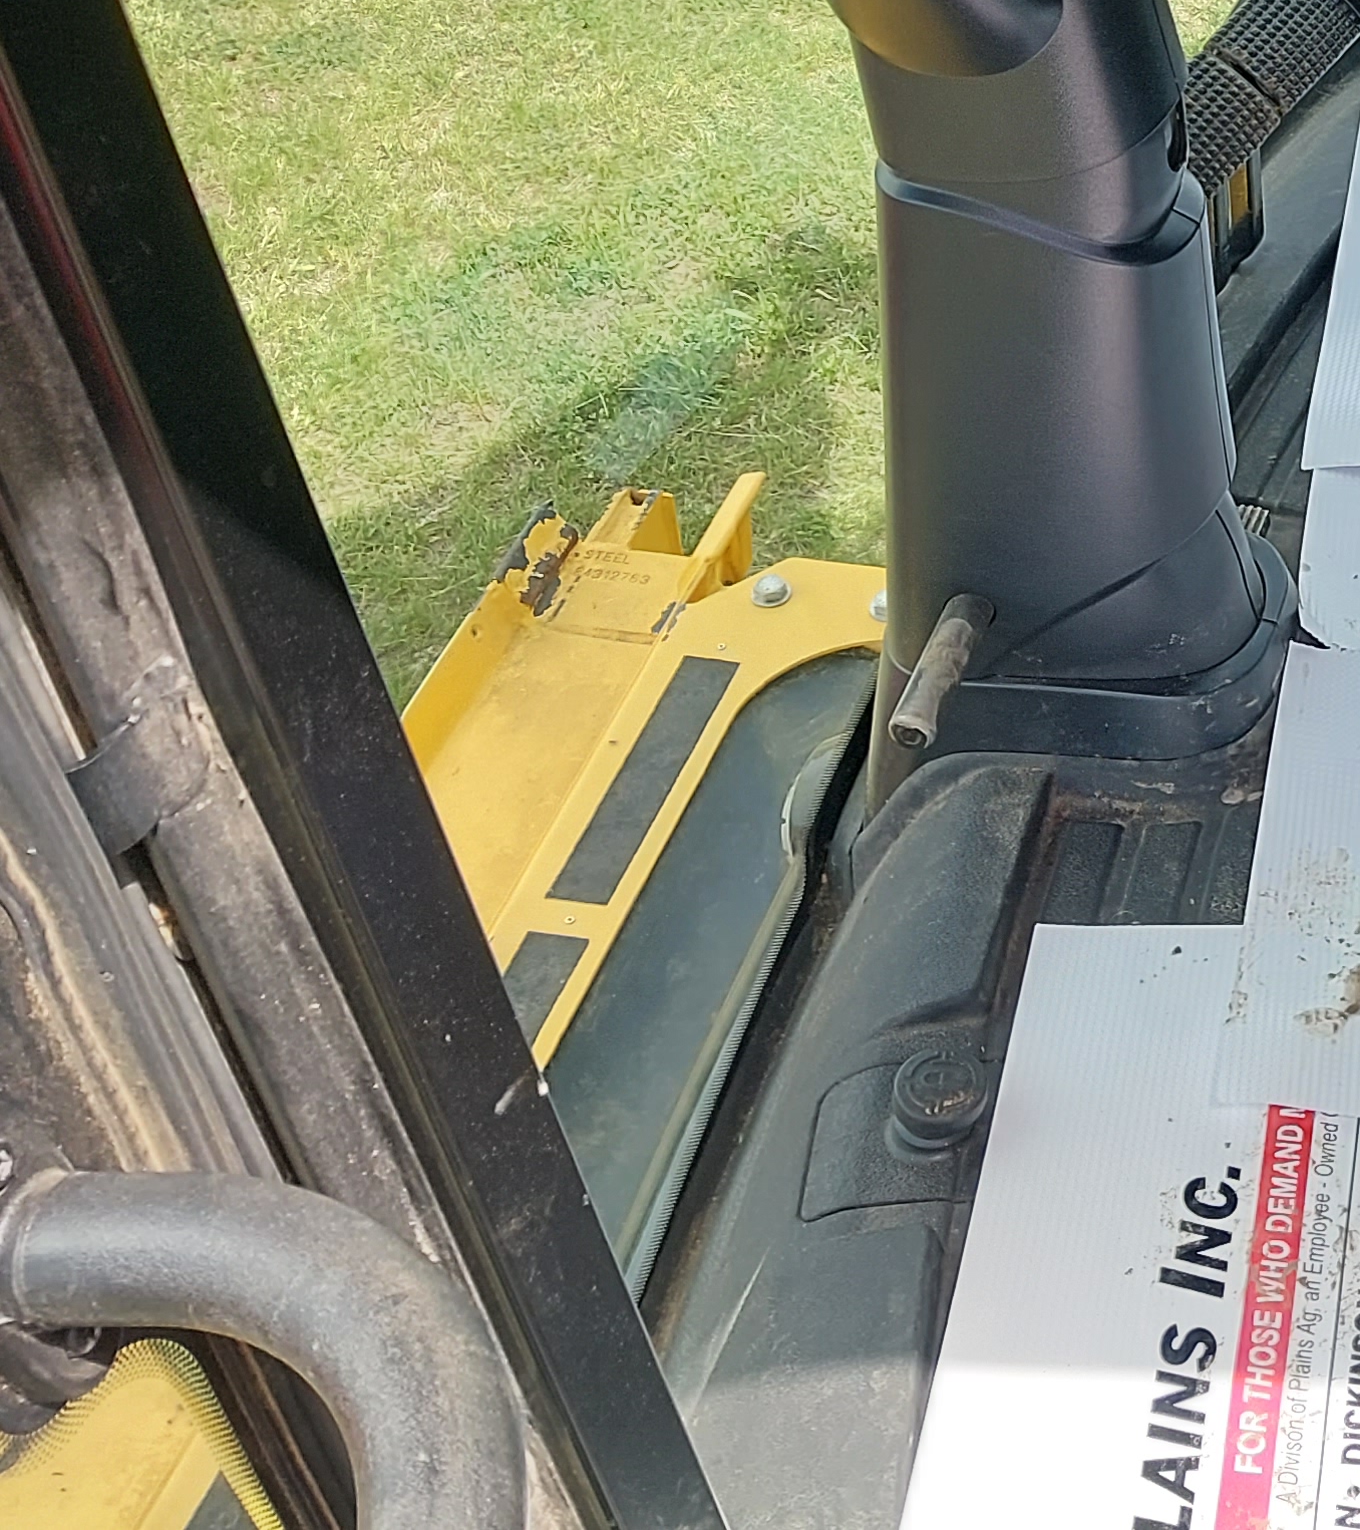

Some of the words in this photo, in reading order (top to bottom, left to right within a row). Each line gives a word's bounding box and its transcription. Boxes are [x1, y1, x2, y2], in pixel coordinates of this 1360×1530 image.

[583, 549, 630, 565] STEEL
[1265, 1124, 1306, 1234] DEMAND
[1314, 1122, 1339, 1177] Owned
[1158, 1165, 1242, 1298] INC.
[1303, 1192, 1333, 1273] Employee
[1256, 1238, 1291, 1303] WHO
[1304, 1279, 1320, 1301] an
[1297, 1309, 1323, 1335] Ag,
[1243, 1309, 1283, 1404] THOSE
[1288, 1338, 1315, 1392] Plains
[1287, 1396, 1307, 1418] of
[1233, 1409, 1269, 1474] FOR
[1277, 1419, 1304, 1486] Divison
[1276, 1490, 1296, 1504] A
